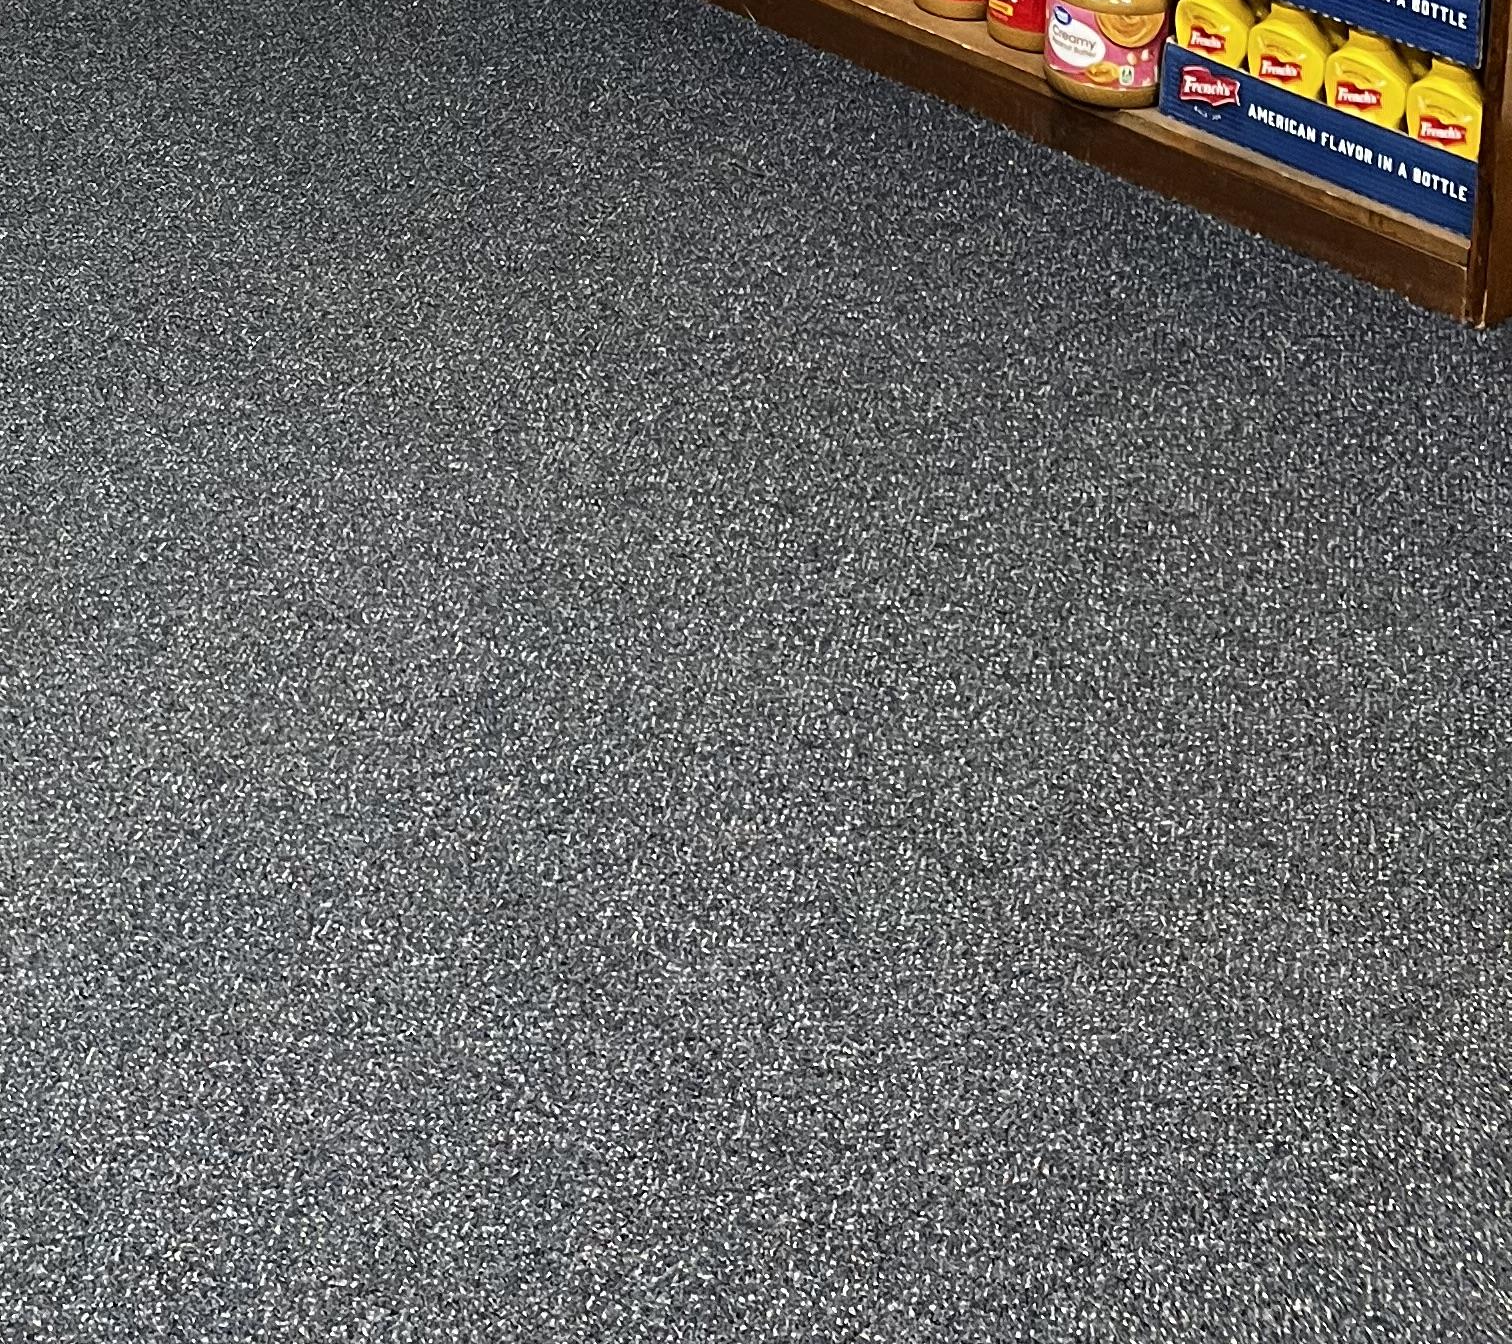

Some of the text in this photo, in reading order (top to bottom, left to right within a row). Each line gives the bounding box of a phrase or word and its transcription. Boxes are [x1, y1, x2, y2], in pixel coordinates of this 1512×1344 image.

[1052, 24, 1098, 52] Creamy
[1260, 56, 1300, 78] French's
[1182, 75, 1233, 99] French's
[1338, 87, 1381, 106] French's
[1421, 122, 1465, 142] French's
[1247, 103, 1317, 142] AMERICAN
[1320, 132, 1374, 166] FLAVOR
[1377, 153, 1393, 174] IN
[1397, 162, 1408, 179] A
[1412, 166, 1469, 202] BOTTLE
